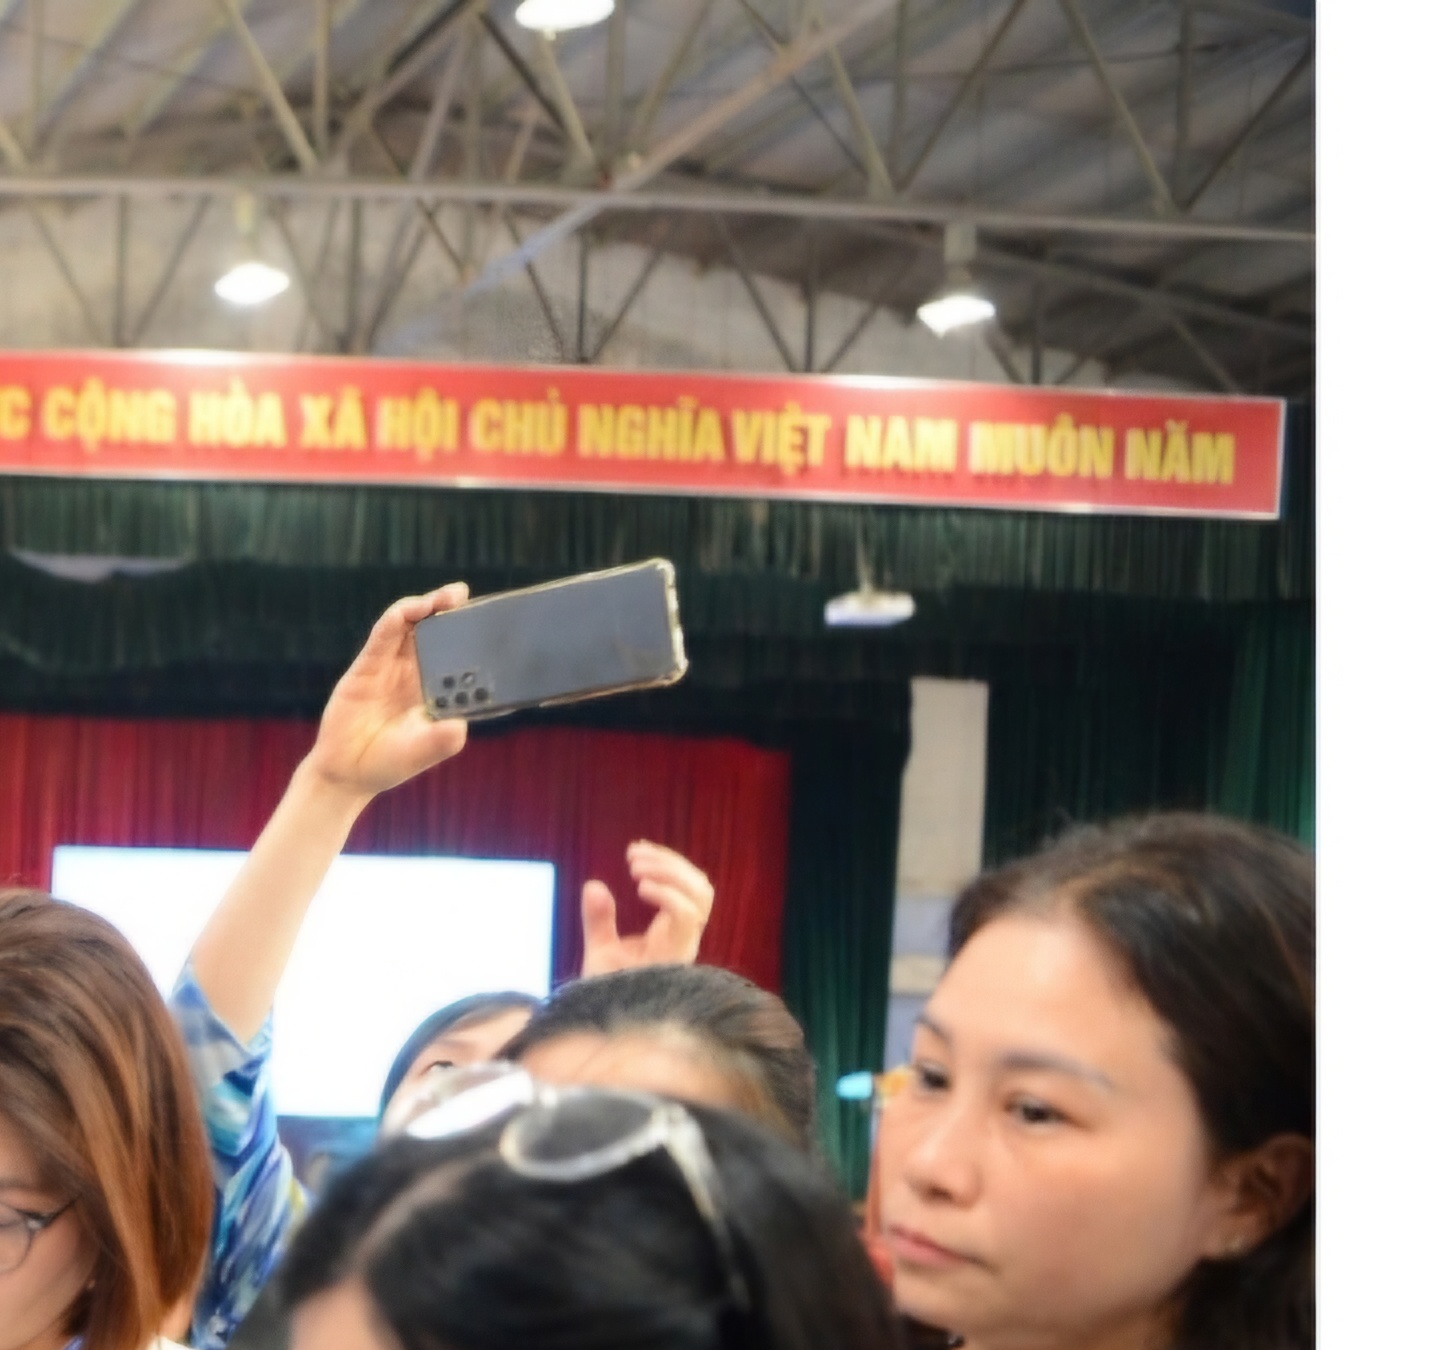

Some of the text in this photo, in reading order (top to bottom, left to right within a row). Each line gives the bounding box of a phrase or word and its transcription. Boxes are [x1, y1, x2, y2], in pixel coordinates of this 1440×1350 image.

[43, 376, 175, 451] CỘNG
[187, 378, 286, 447] HÒA
[299, 385, 367, 450] XÃ
[378, 388, 458, 459] HỘI
[471, 389, 566, 456] CHỦ
[578, 397, 724, 461] NGHĨA
[731, 401, 832, 475] VIỆT
[844, 414, 959, 472] NAM
[969, 413, 1114, 478] MUÔN
[1126, 420, 1235, 484] NĂM
